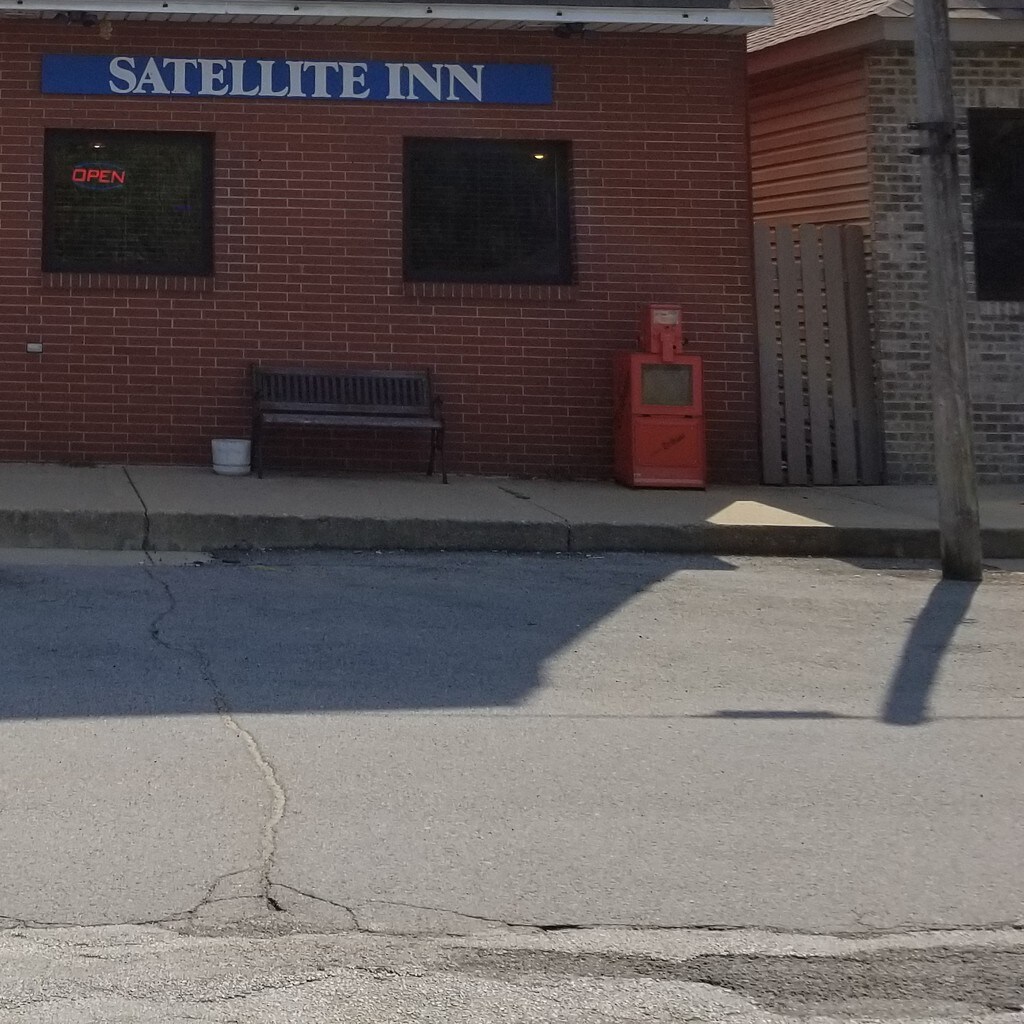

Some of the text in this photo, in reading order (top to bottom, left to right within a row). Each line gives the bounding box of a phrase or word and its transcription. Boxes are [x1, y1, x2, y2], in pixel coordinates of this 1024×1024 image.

[109, 56, 485, 102] SATELLITE INN
[71, 168, 126, 184] OPEN
